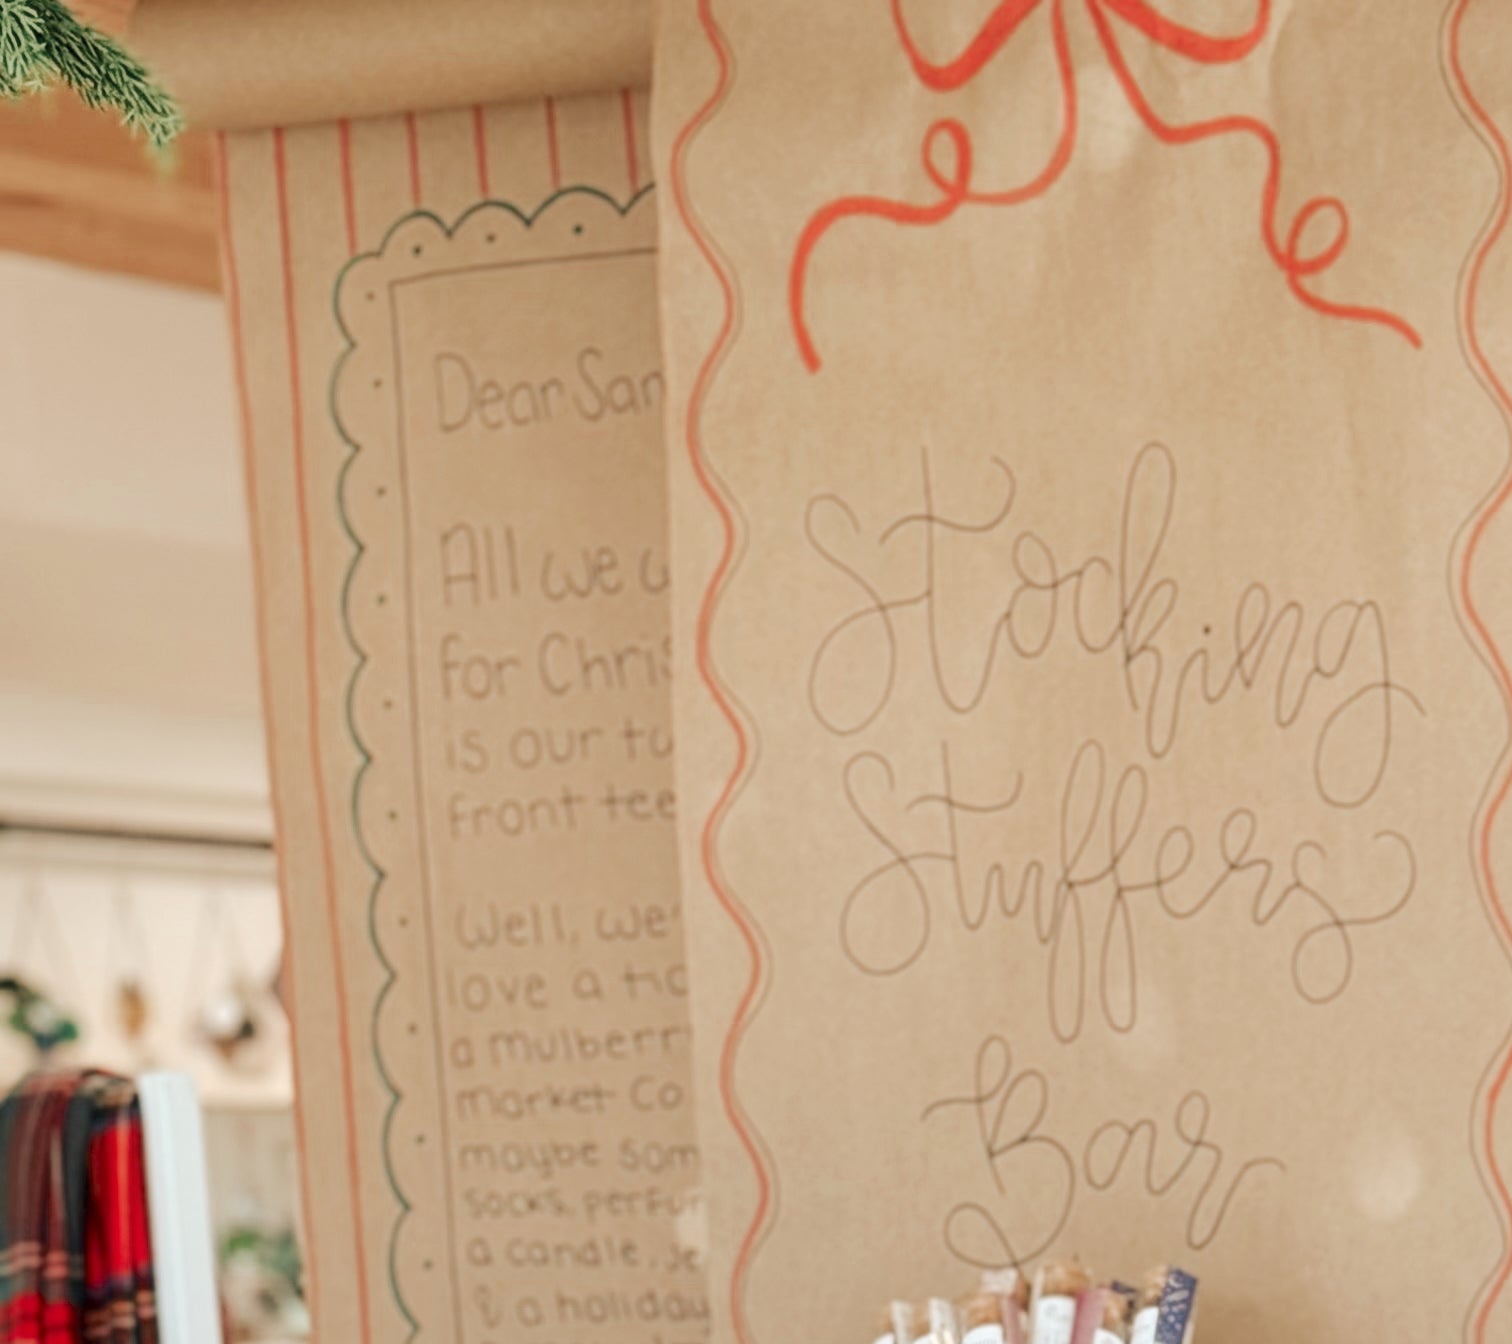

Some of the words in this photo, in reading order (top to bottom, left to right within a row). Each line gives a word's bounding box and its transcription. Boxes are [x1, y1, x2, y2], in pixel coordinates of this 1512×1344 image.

[434, 350, 564, 434] Dear
[440, 521, 521, 606] All
[540, 544, 625, 603] we
[804, 441, 1428, 809] Stocking
[445, 728, 489, 775] is
[508, 726, 604, 770] our
[447, 782, 586, 841] front
[453, 900, 580, 952] Well,
[839, 739, 1418, 1045] Stuffers
[445, 962, 549, 1013] love
[571, 967, 604, 1001] a
[449, 1035, 476, 1069] a
[920, 1034, 1287, 1282] Bar
